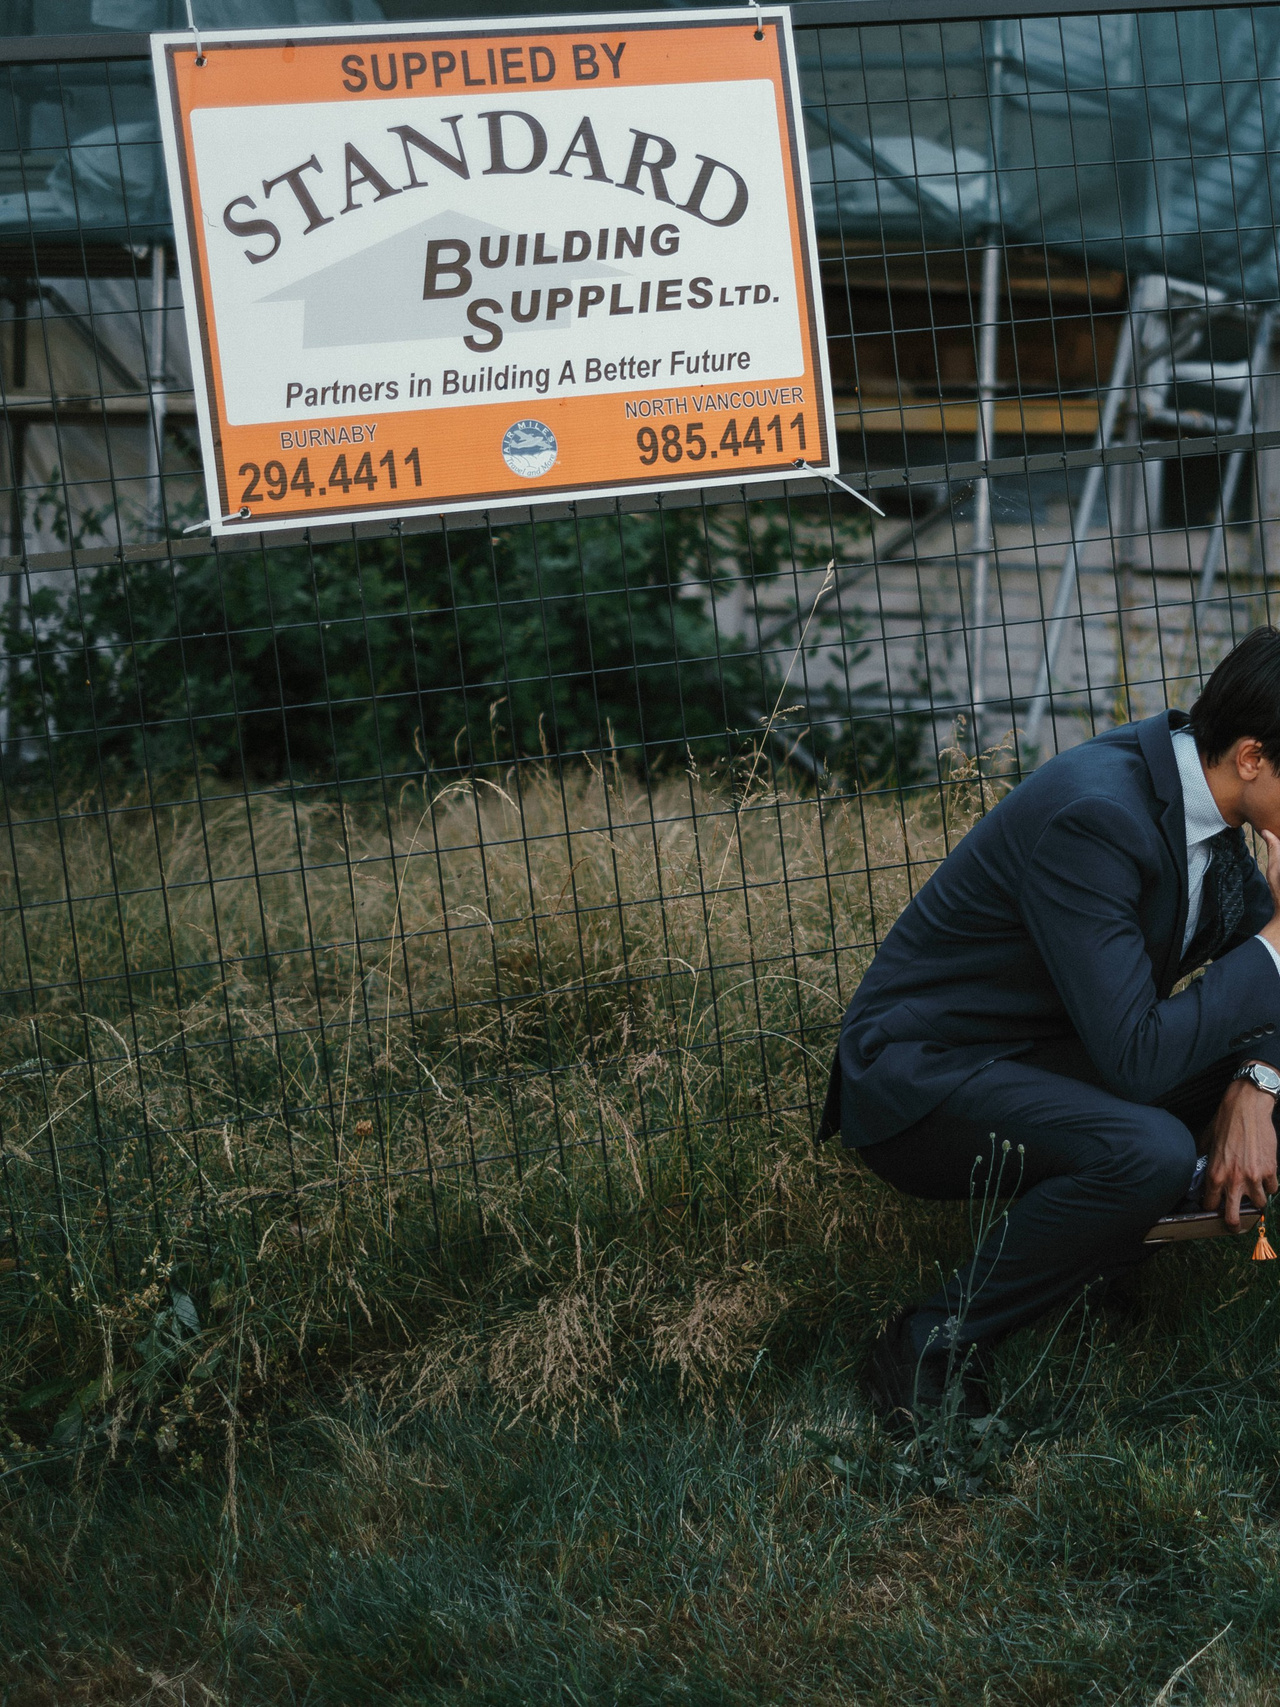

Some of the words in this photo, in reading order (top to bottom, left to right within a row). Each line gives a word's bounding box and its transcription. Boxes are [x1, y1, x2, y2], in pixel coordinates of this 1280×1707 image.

[341, 44, 557, 92] SUPPLIED
[573, 42, 626, 81] BY
[222, 109, 749, 265] STANDARD
[422, 223, 681, 301] BUILDING
[463, 276, 714, 353] SUPPLIES
[719, 283, 780, 307] LTD.
[285, 377, 399, 409] Partners
[408, 372, 432, 399] in
[442, 362, 550, 396] Building
[557, 360, 576, 386] A
[585, 354, 663, 383] Better
[670, 349, 751, 376] Future
[624, 396, 689, 420] NORTH
[691, 386, 805, 415] VANCOUVER
[279, 423, 377, 450] BURNABY
[517, 421, 555, 443] MILES
[636, 412, 808, 466] 985.4411
[238, 447, 423, 504] 294.4411
